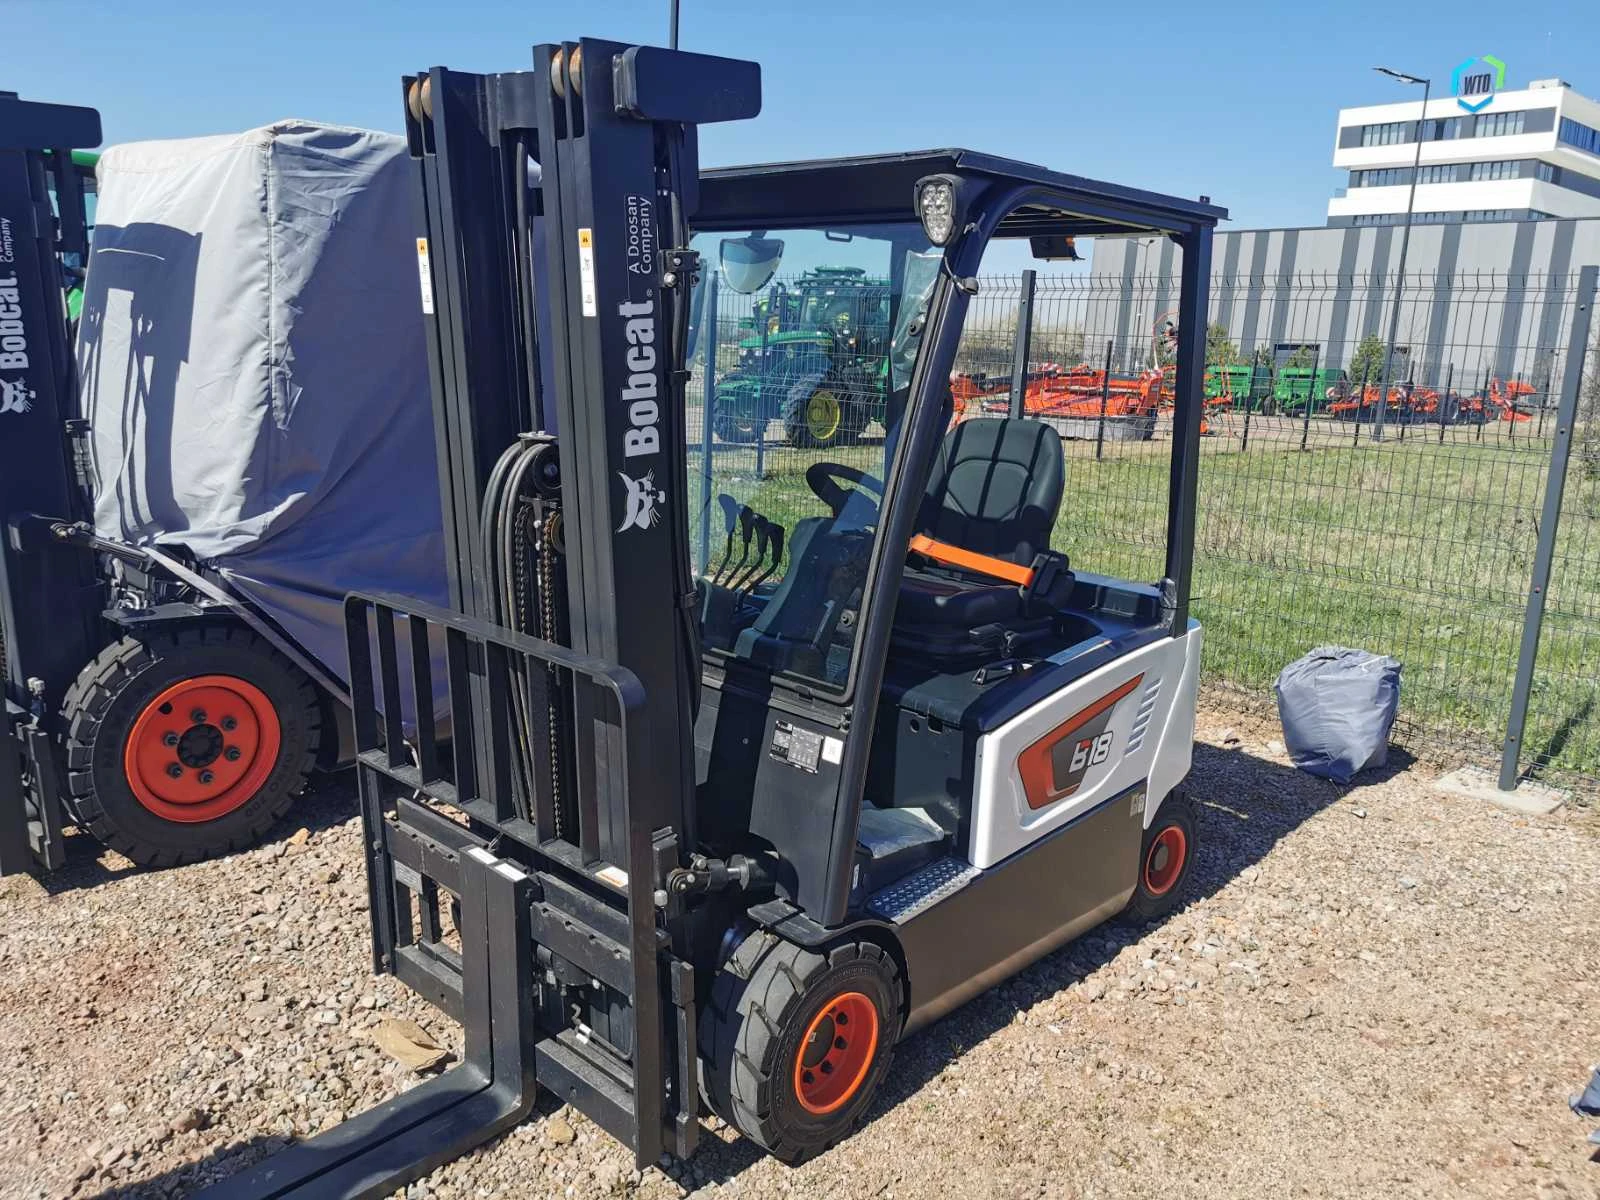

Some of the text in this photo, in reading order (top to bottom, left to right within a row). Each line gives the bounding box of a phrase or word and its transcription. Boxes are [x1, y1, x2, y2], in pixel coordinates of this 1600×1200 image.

[1, 217, 15, 262] Company
[627, 196, 640, 274] A Doosan
[639, 198, 653, 274] Company
[619, 300, 659, 457] Bobcat
